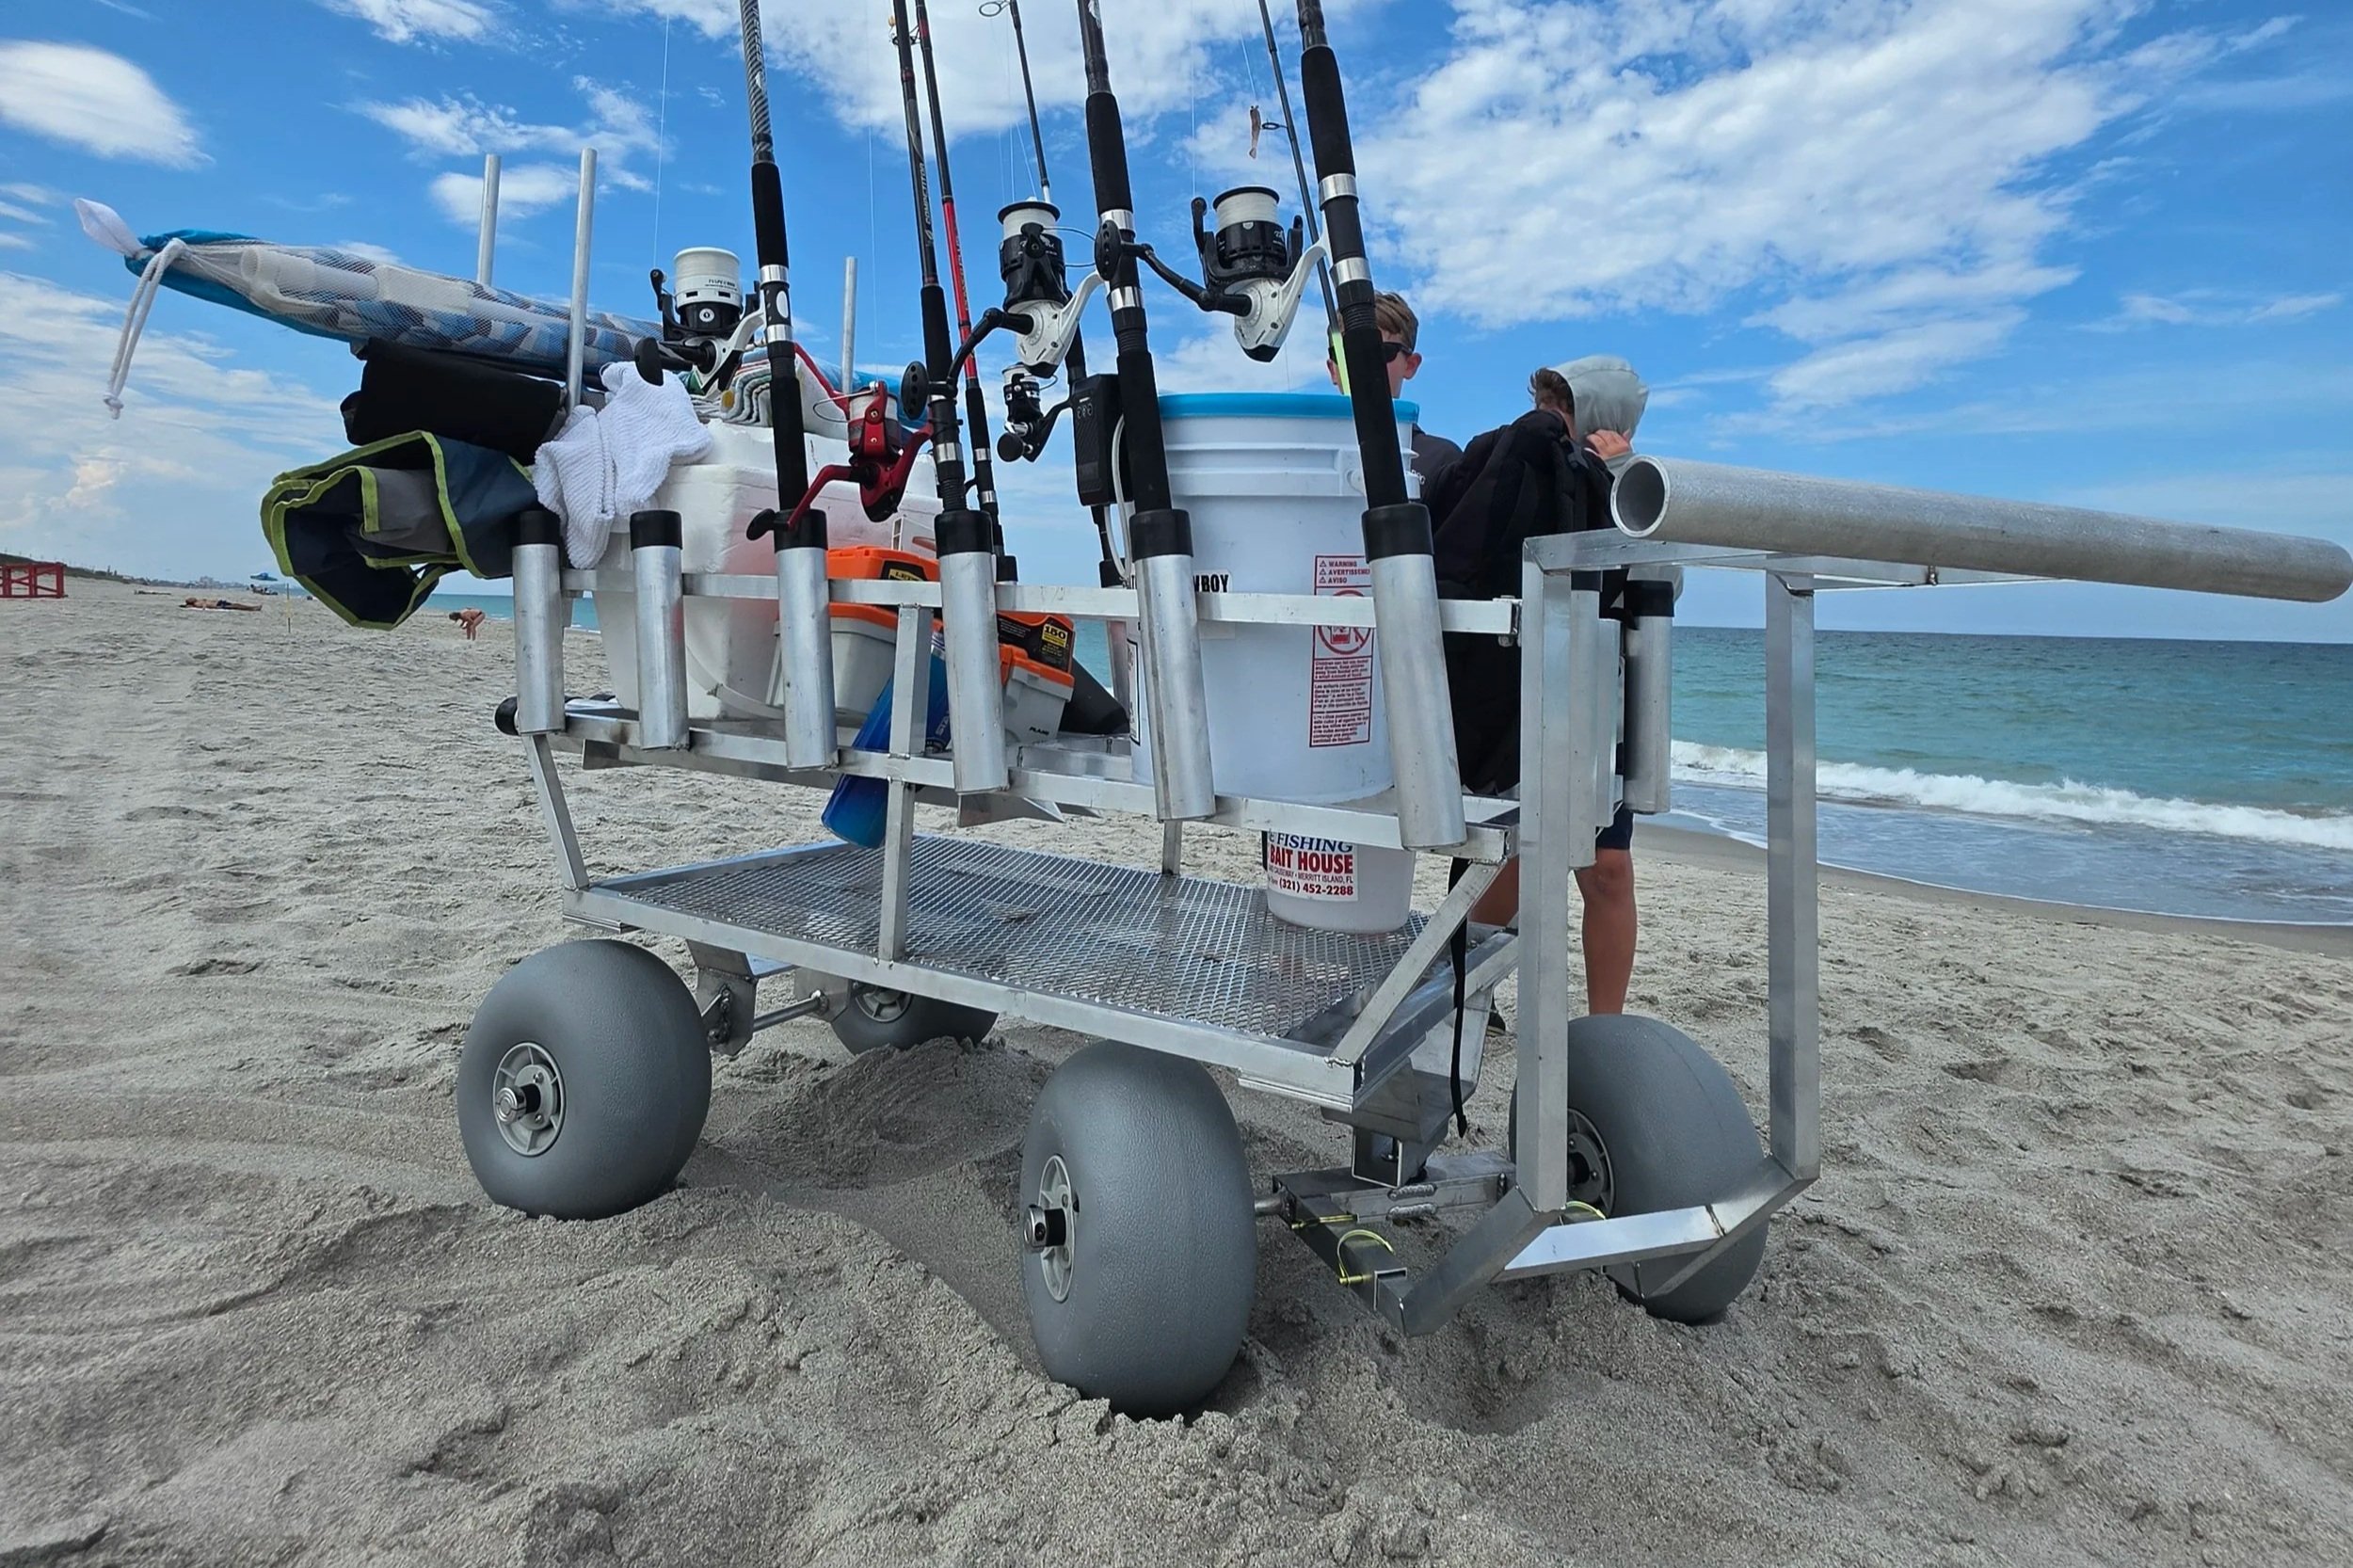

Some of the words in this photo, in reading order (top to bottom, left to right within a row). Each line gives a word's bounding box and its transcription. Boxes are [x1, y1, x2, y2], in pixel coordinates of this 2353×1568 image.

[1045, 626, 1066, 639] 150
[1277, 832, 1353, 853] FISHING
[1270, 843, 1293, 869] BAIT
[1298, 851, 1353, 874] HOUSE
[1279, 877, 1301, 893] (321)
[1303, 883, 1353, 896] 452-2288
[1299, 872, 1321, 882] MERRITT
[1322, 874, 1345, 885] ISLAND,
[1346, 875, 1353, 884] FL
